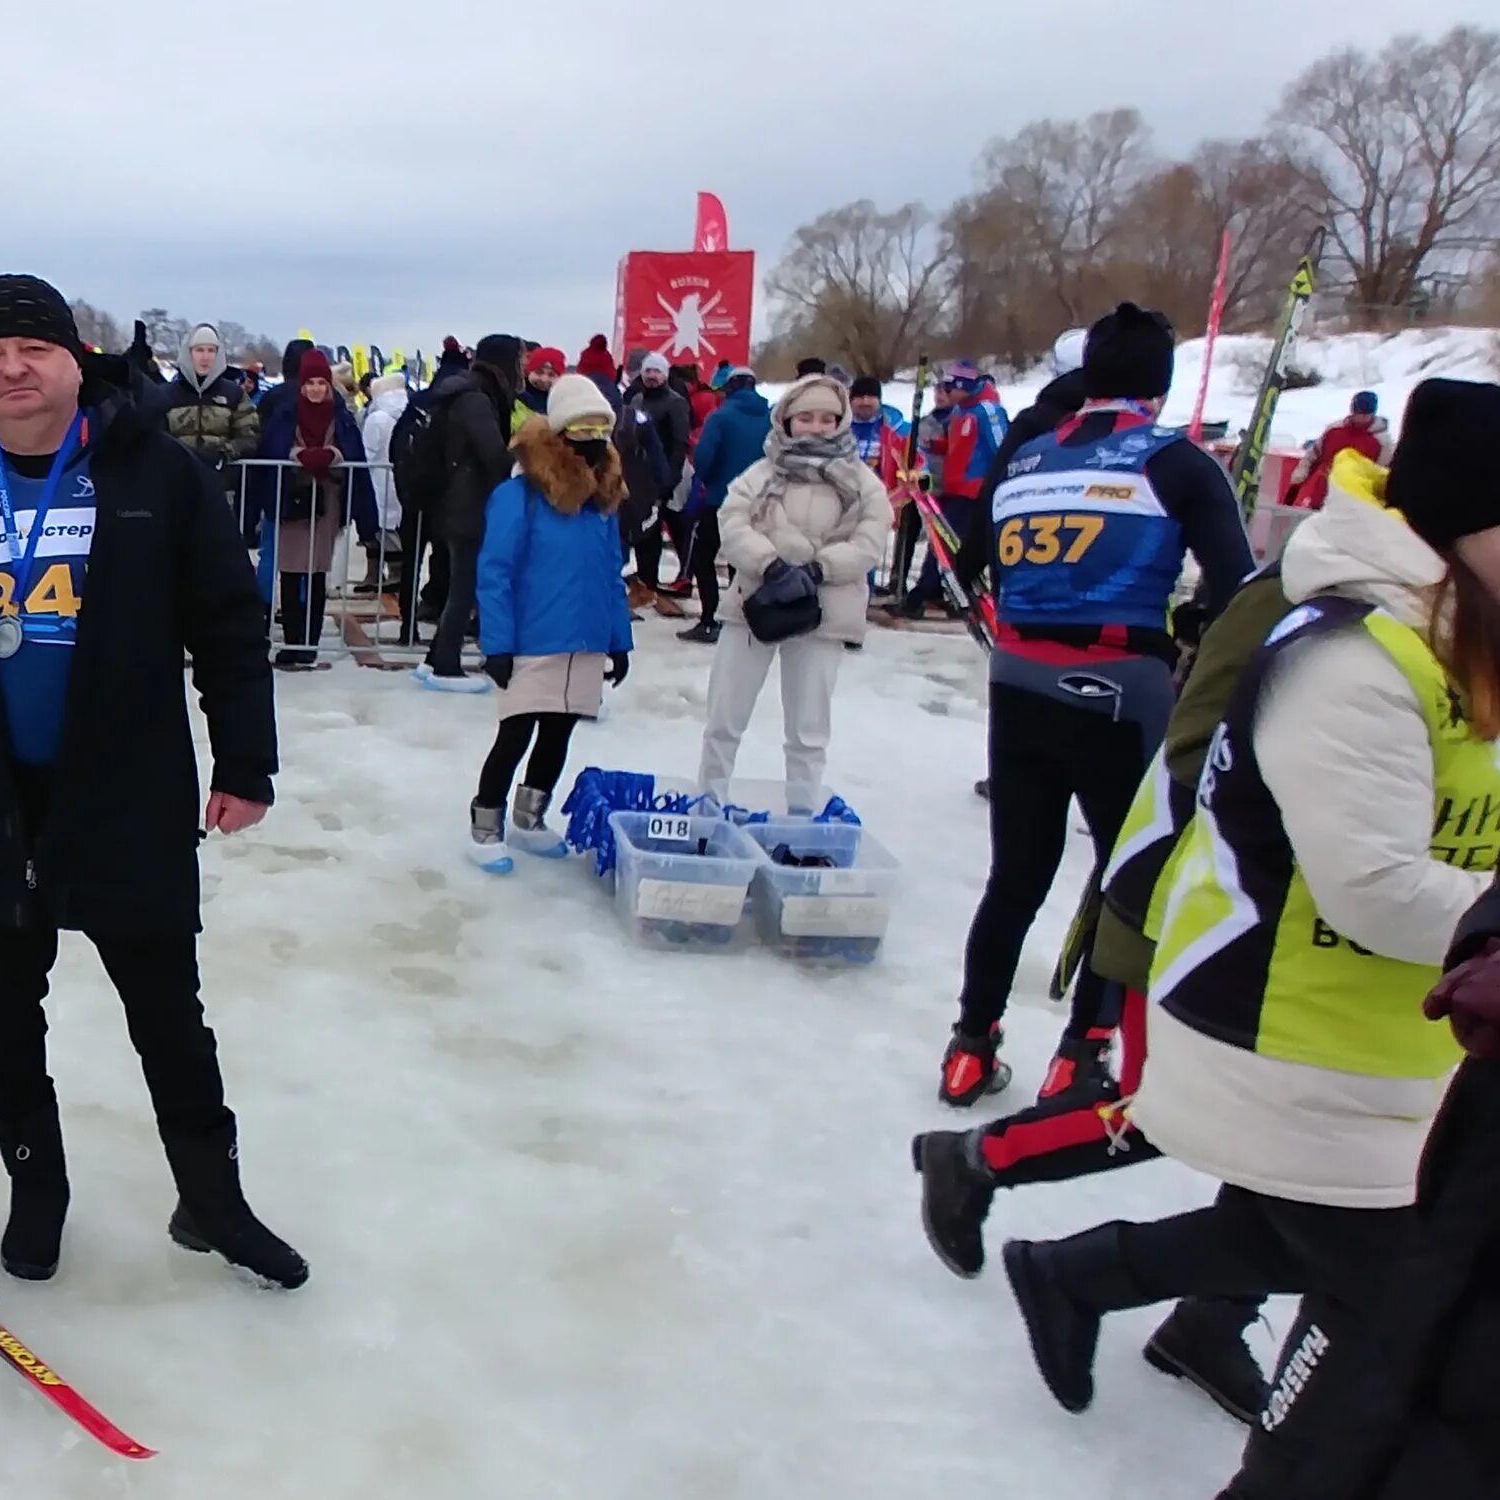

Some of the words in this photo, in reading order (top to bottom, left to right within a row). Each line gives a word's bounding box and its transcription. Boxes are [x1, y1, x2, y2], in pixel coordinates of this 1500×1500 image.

[1084, 485, 1133, 499] PRO
[999, 515, 1105, 567] 637
[650, 818, 689, 837] 018
